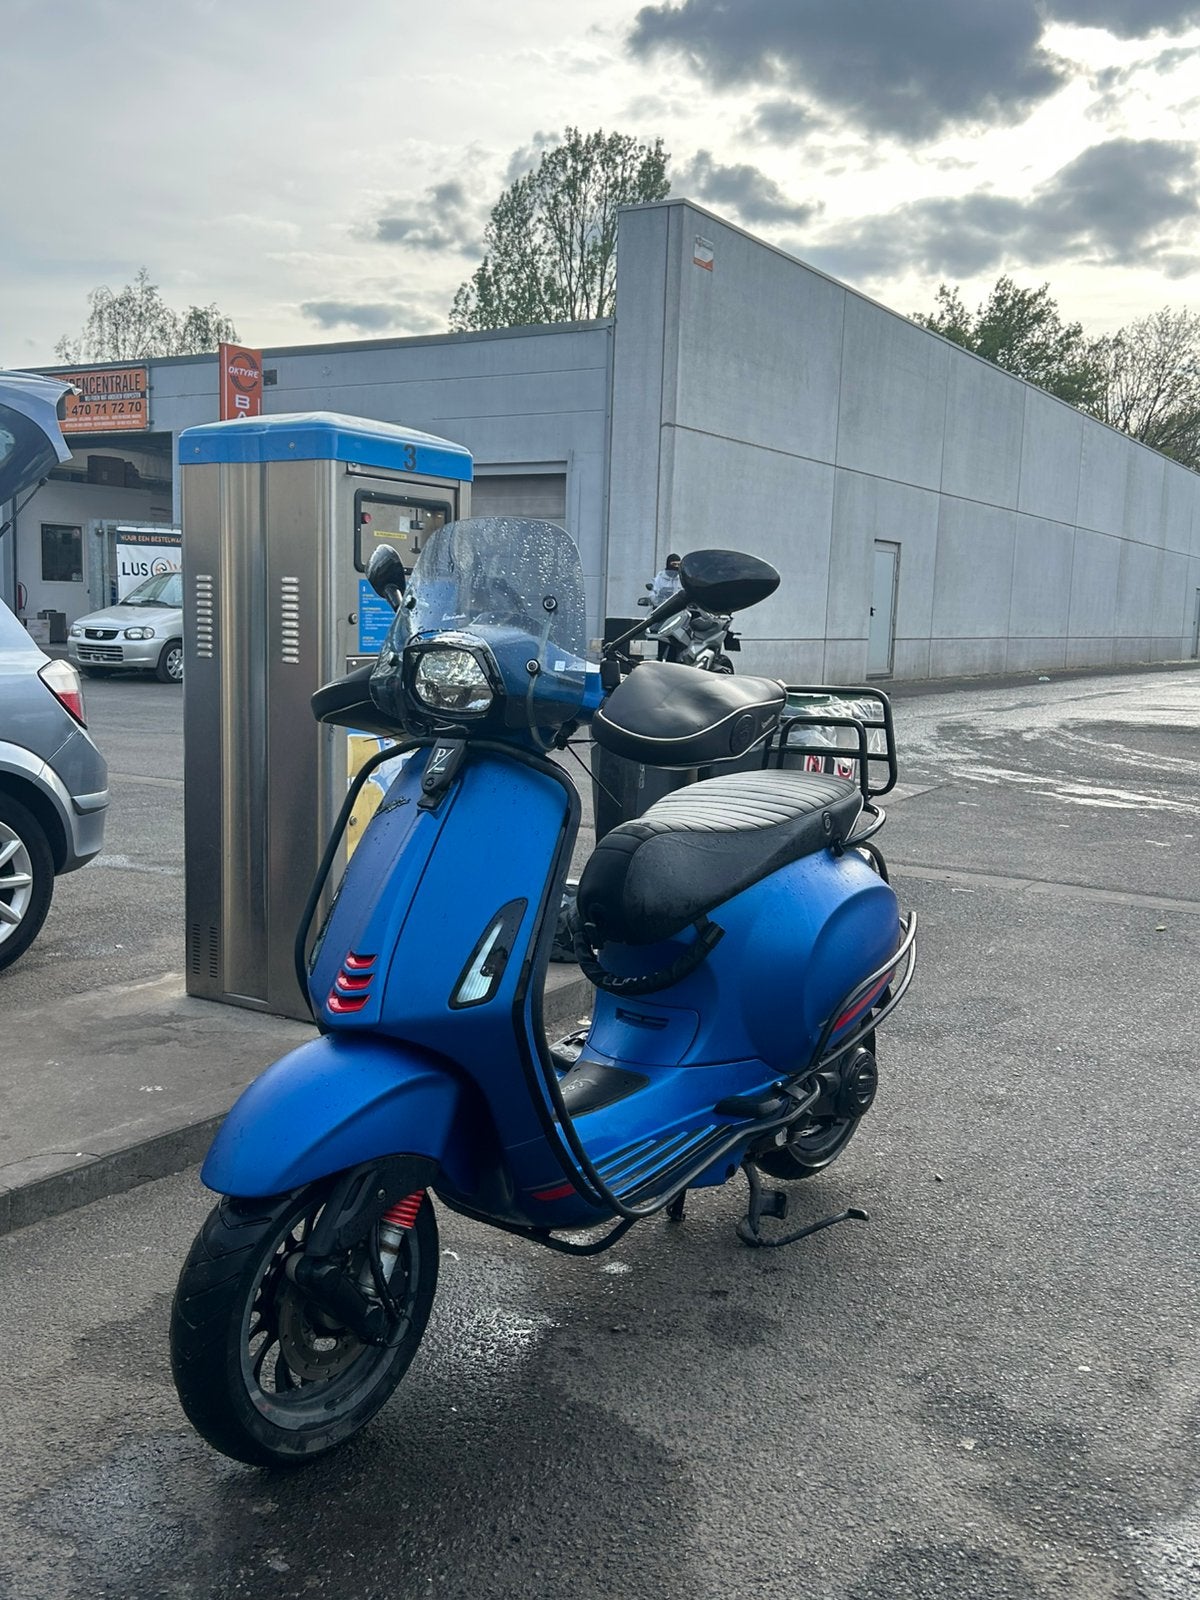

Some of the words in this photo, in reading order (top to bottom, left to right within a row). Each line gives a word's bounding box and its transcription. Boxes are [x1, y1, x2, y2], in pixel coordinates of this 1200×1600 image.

[229, 366, 260, 379] OKTYRE
[63, 373, 141, 395] ENCENTRALE
[72, 404, 91, 416] 470
[95, 403, 107, 415] 71
[111, 402, 125, 414] 72
[128, 401, 142, 413] 70
[403, 444, 417, 471] 3
[122, 562, 149, 577] LUS
